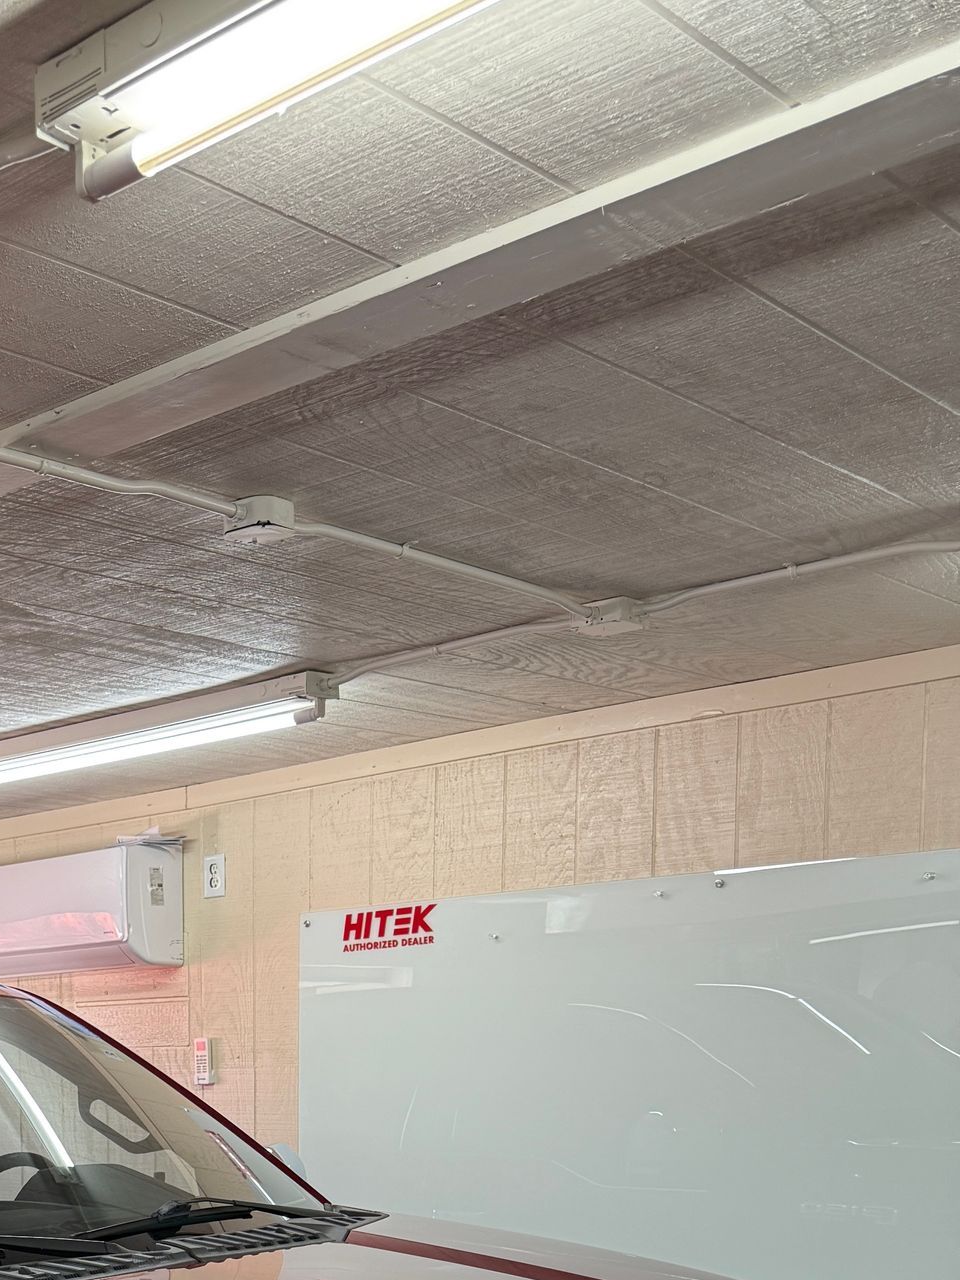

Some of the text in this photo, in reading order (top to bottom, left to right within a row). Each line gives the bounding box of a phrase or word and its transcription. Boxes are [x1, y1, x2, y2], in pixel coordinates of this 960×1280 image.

[343, 904, 437, 941] HITEK
[343, 935, 434, 952] AUTHORIZED DEALER
